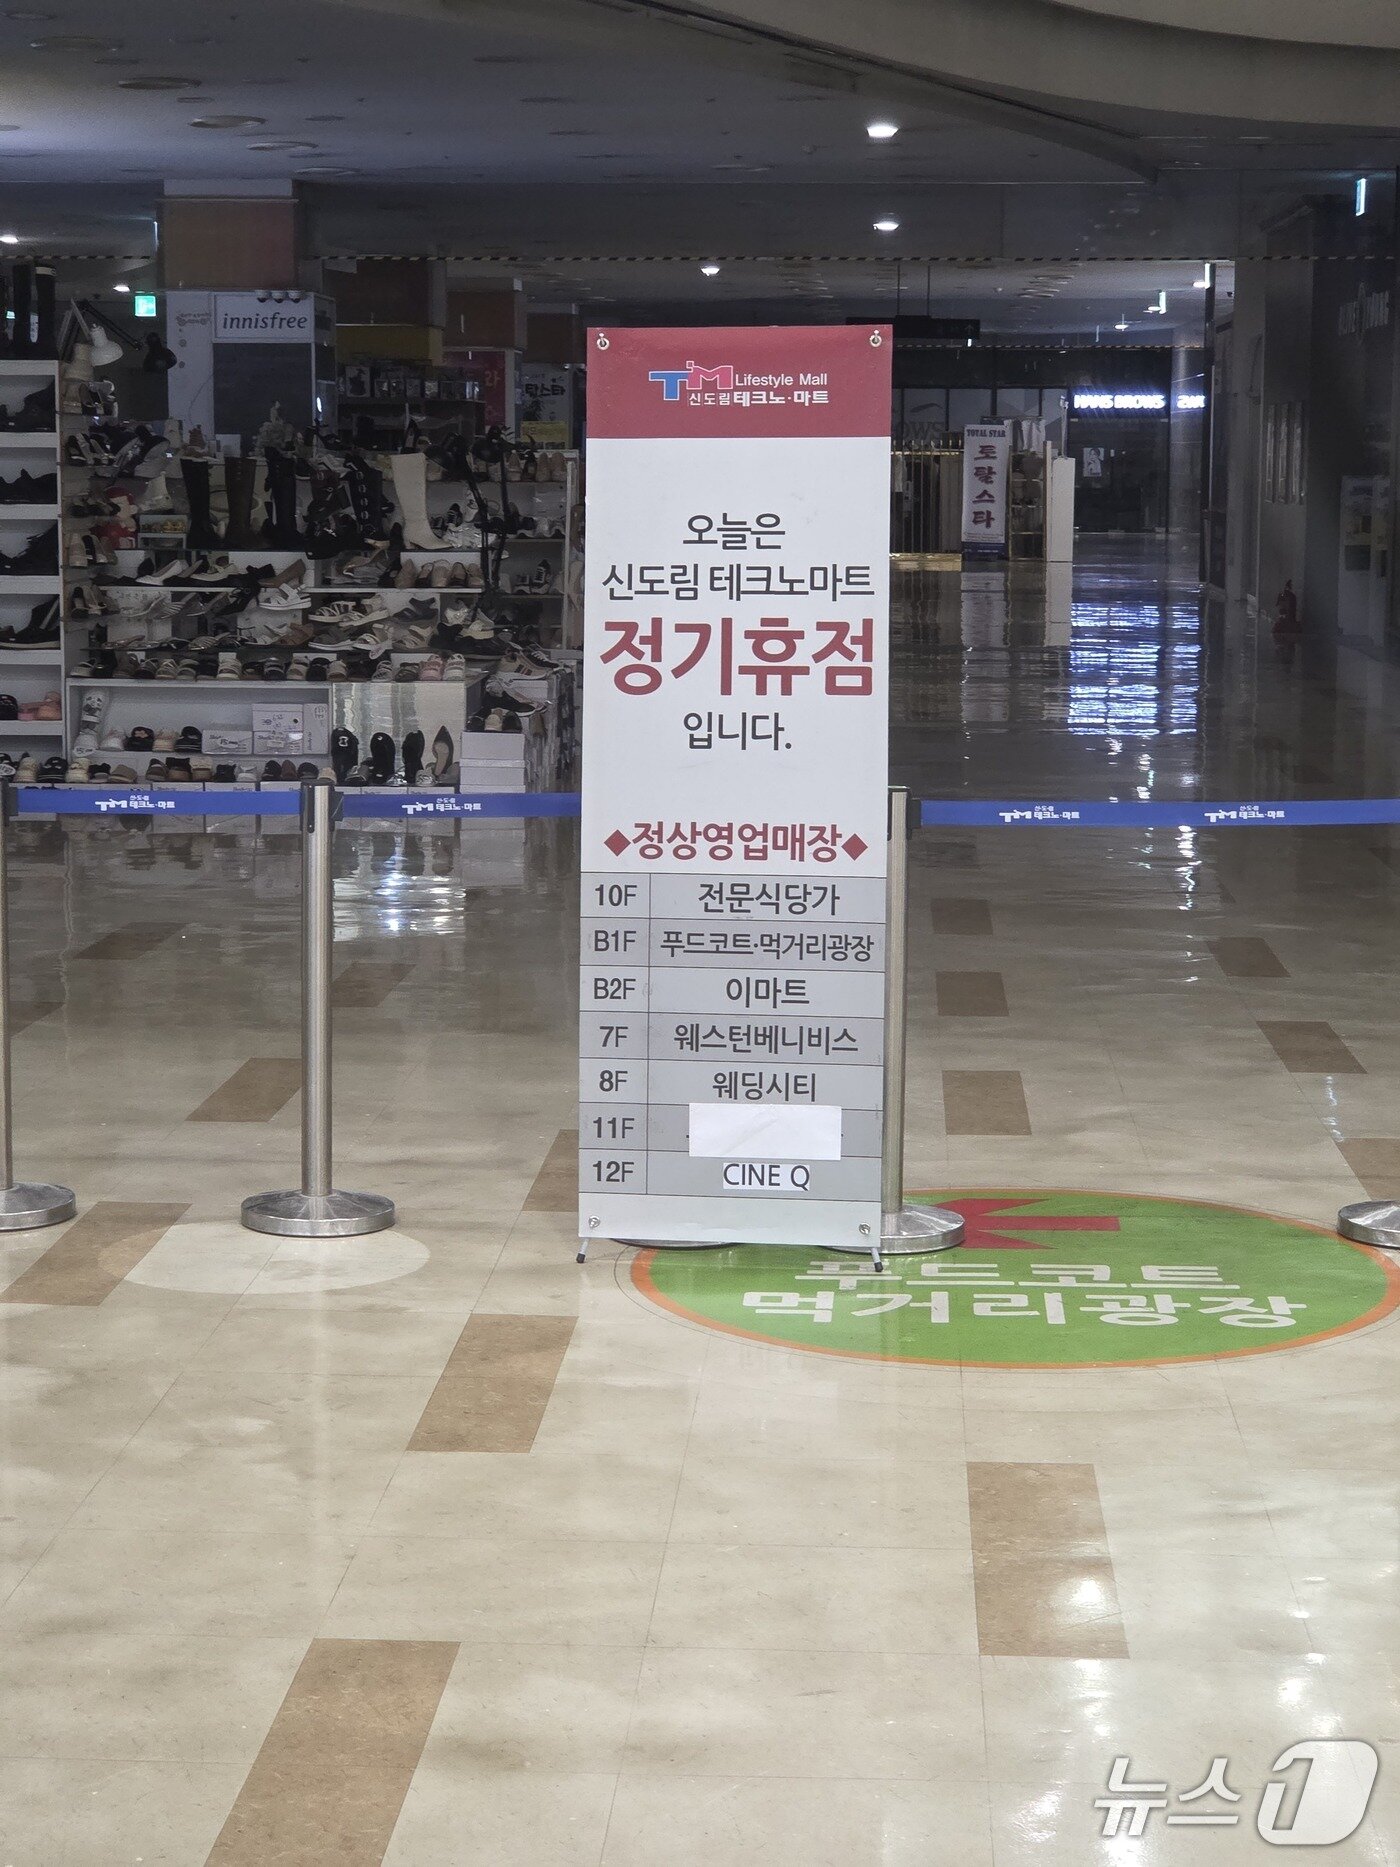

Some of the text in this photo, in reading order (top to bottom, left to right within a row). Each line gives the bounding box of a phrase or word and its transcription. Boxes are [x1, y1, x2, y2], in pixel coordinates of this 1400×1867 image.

[223, 311, 308, 330] innisfree
[735, 373, 828, 389] Lifestyle Mall
[688, 392, 731, 406] 신도림
[966, 429, 1006, 437] TOTAL STAR
[972, 444, 997, 529] 토탈스타
[683, 513, 785, 551] 오늘은
[602, 563, 875, 602] 신도림 테크노마트
[600, 617, 874, 697] 정기휴점
[684, 712, 792, 750] 입니다.
[631, 820, 843, 862] 정상영업매장
[594, 883, 637, 907] 10F
[698, 882, 840, 916] 전문식당가
[594, 930, 637, 953] B1F
[660, 930, 874, 963] 푸드코트·먹거리광장
[593, 977, 636, 1000] B2F
[726, 977, 810, 1009] 이마트
[600, 1025, 629, 1048] 7F
[673, 1024, 859, 1055] 웨스턴베니비스
[599, 1070, 628, 1092] 8F
[712, 1071, 817, 1102] 웨딩시티
[592, 1117, 635, 1139] 11F
[592, 1160, 634, 1183] 12F
[723, 1163, 810, 1191] CINE Q
[795, 1261, 1241, 1291] 푸드코트
[742, 1290, 1308, 1329] 먹거리광장
